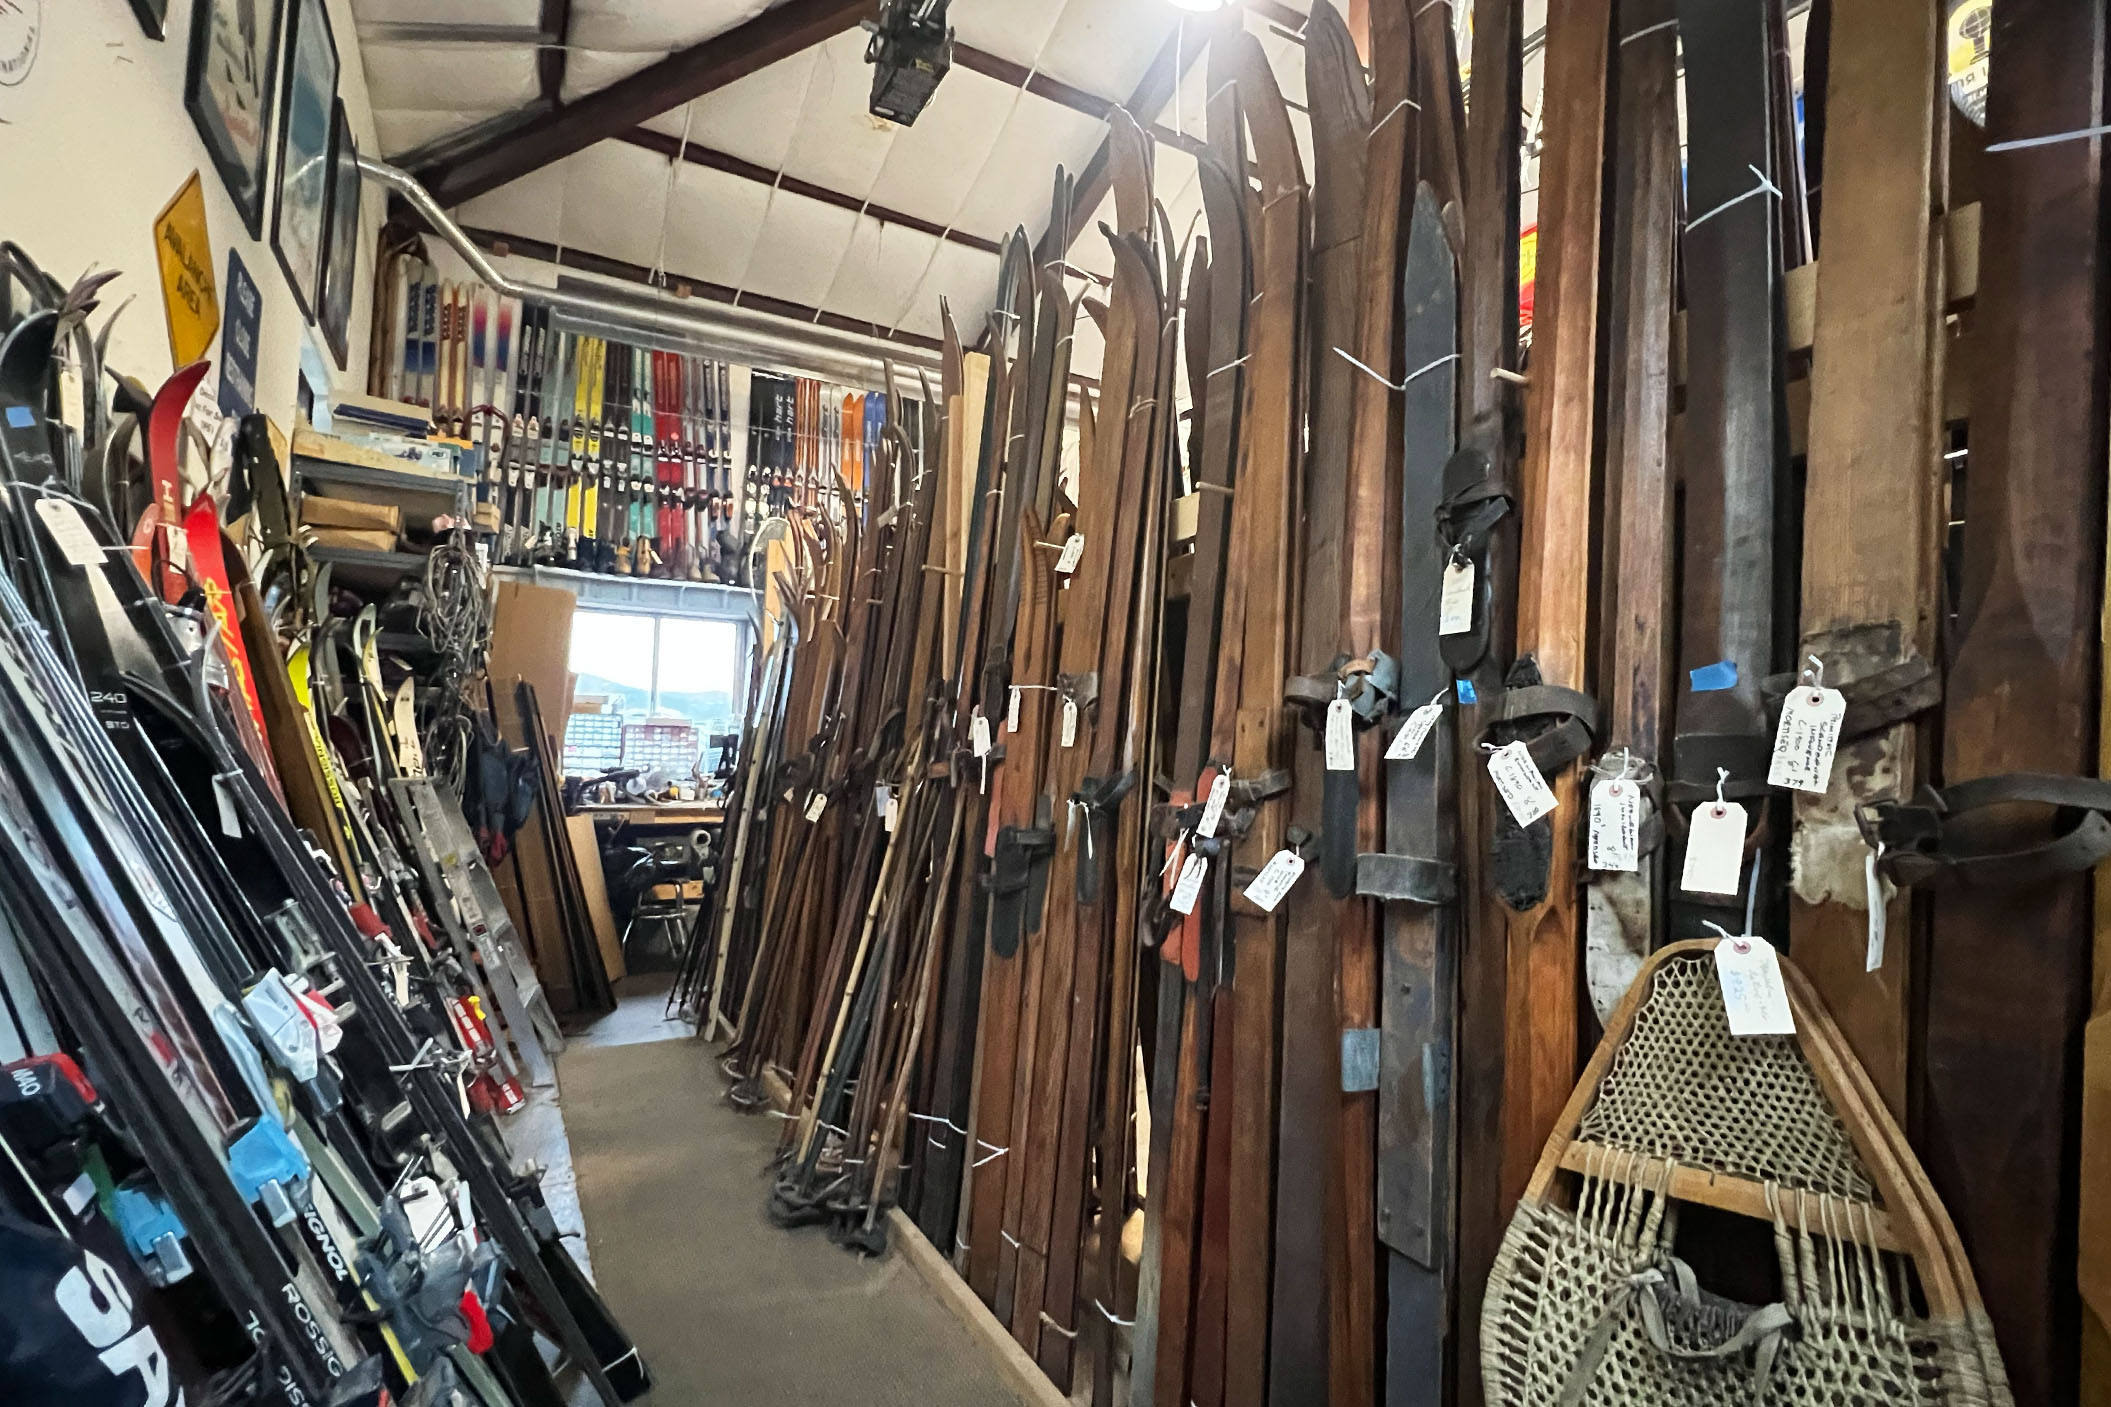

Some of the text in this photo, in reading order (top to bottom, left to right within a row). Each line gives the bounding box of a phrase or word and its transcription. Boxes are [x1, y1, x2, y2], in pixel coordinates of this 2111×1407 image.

[774, 393, 783, 424] hart
[785, 395, 795, 426] hart
[90, 691, 127, 704] 240
[105, 720, 130, 729] STD
